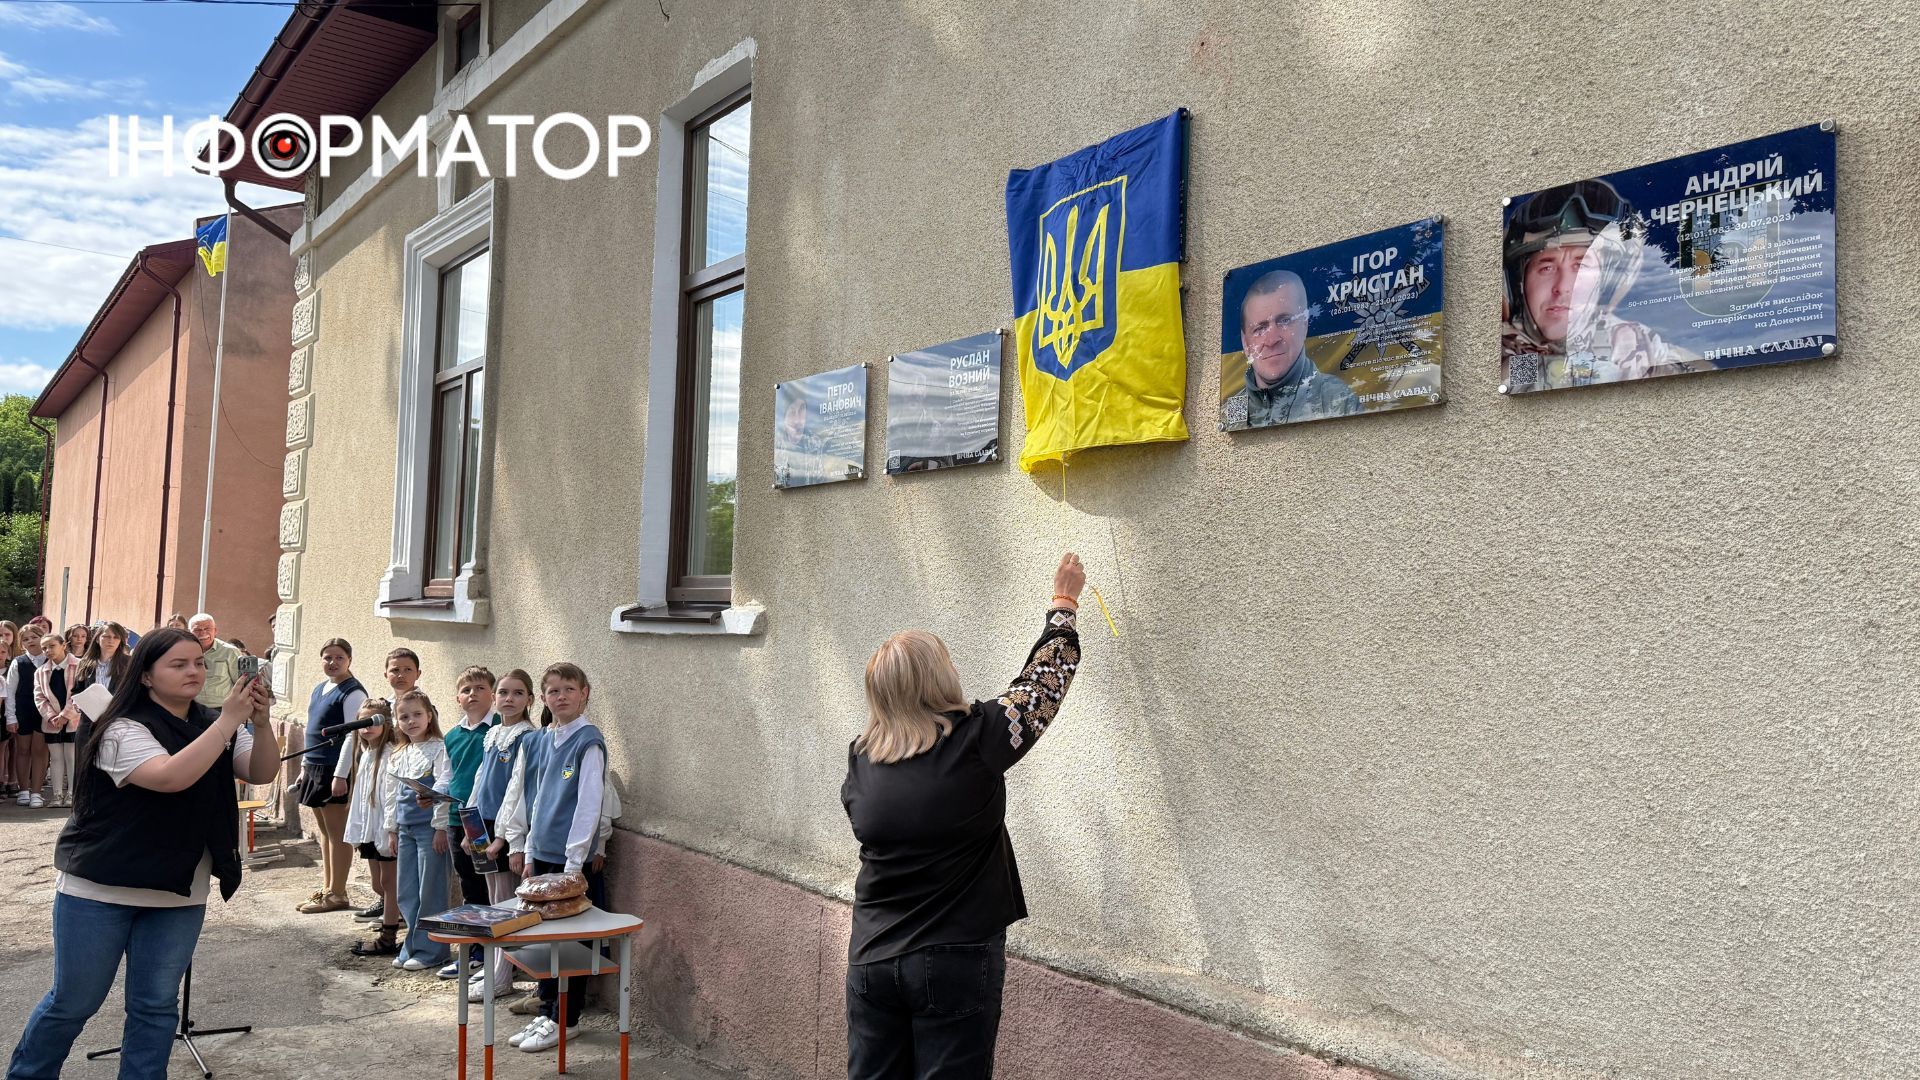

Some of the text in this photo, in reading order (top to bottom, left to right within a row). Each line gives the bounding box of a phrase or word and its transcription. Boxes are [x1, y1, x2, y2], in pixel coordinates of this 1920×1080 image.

[1685, 152, 1783, 196] АНДРІЙ
[1650, 168, 1823, 225] ЧЕРНЕЦЬКИЙ
[1774, 232, 1820, 246] відділення
[1352, 247, 1398, 274] ІГОР
[1765, 243, 1822, 259] призначення
[1701, 263, 1761, 279] оперативного
[1763, 252, 1820, 268] призначення
[1709, 260, 1822, 286] стрілецького батальйону
[1327, 264, 1424, 303] ХРИСТАН
[1650, 295, 1671, 305] полку
[1695, 283, 1743, 296] полковника
[1745, 277, 1777, 287] Семена
[1779, 270, 1822, 282] Височана
[1729, 290, 1822, 312] Загинув внаслідок
[1691, 301, 1822, 327] артилерійського обстрілу
[1755, 312, 1822, 328] на Донеччині
[1760, 336, 1822, 353] СЛАВА!
[950, 350, 990, 370] РУСЛАН
[949, 365, 990, 388] ВОЗНИЙ
[827, 382, 854, 399] ПЕТРО
[1393, 385, 1431, 398] СЛАВА!
[820, 395, 862, 414] ІВАНОВИЧ
